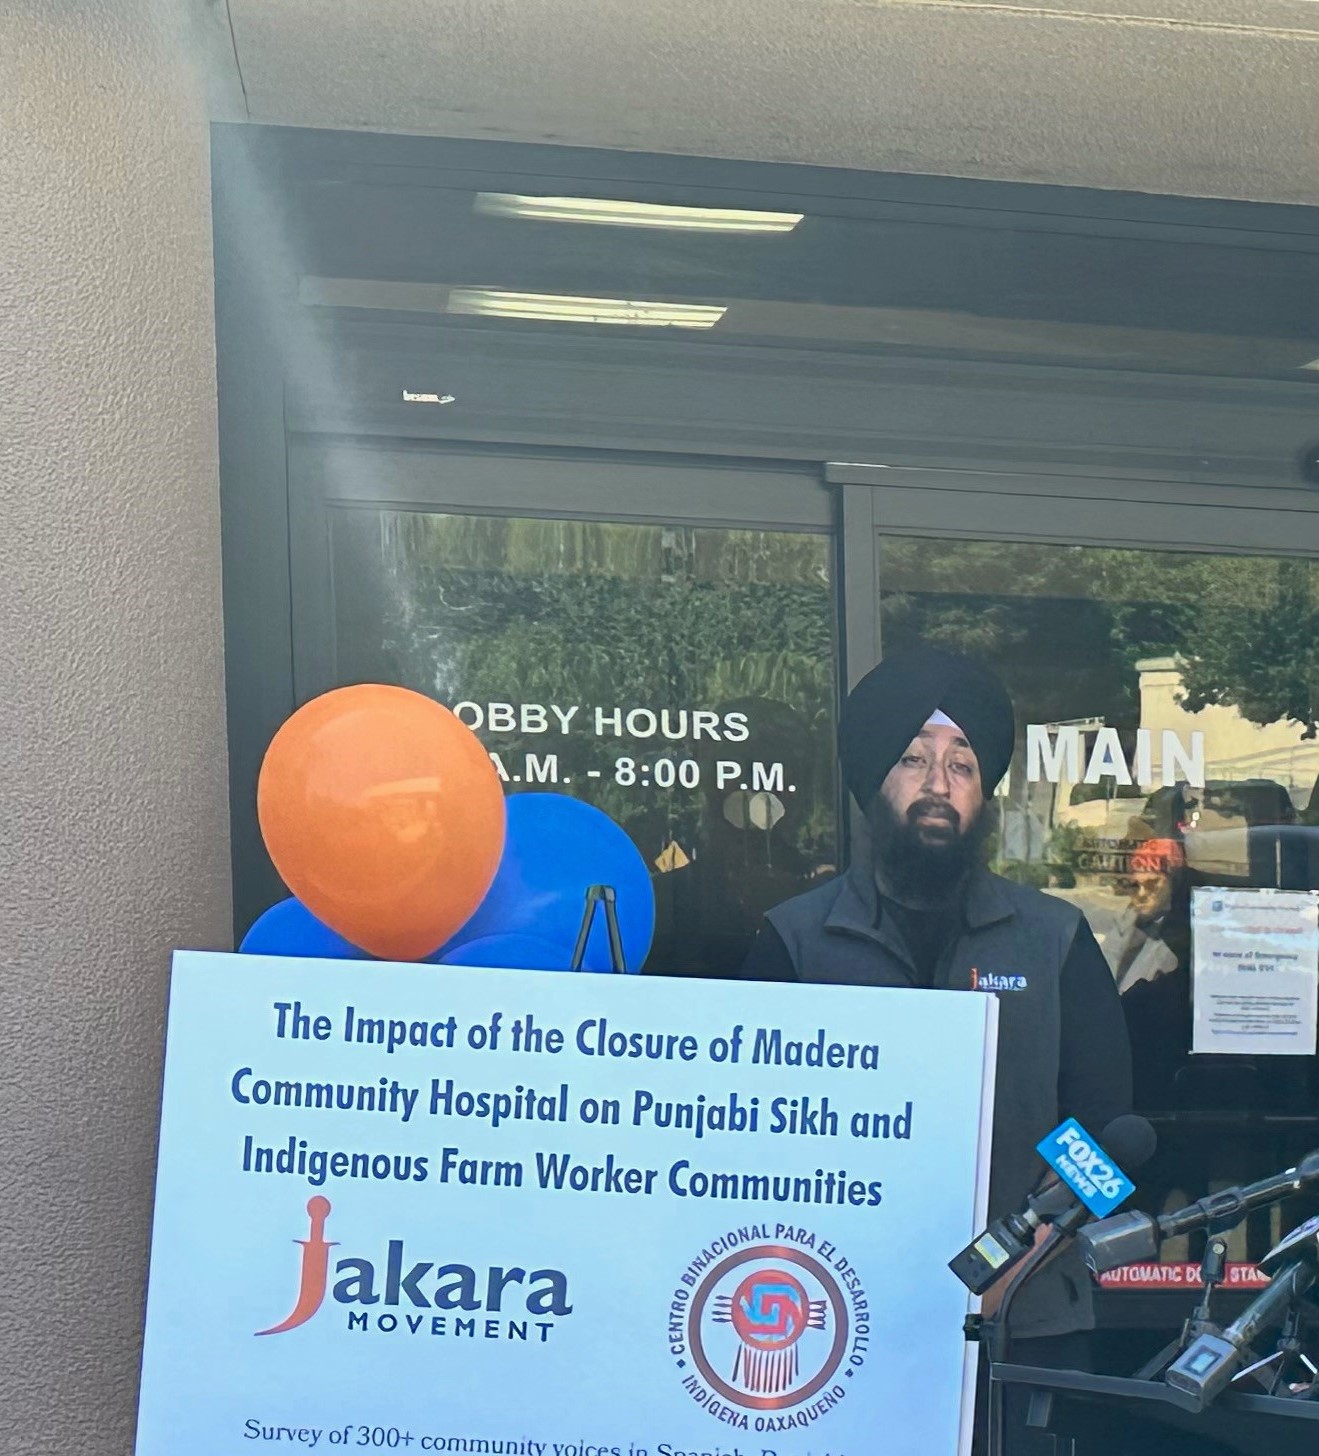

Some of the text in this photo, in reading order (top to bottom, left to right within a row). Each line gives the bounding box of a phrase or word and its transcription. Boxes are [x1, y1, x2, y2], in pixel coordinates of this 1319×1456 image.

[595, 707, 749, 742] HOURS
[1025, 724, 1206, 788] MAIN
[489, 752, 571, 784] A.M.
[614, 758, 700, 789] 8:00
[716, 761, 797, 792] P.M.
[273, 1003, 880, 1070] The Impact of the Closure of Madera
[231, 1069, 913, 1140] Community Hospital on Punjabi Sikh and
[242, 1137, 882, 1206] Indigenous Farm Worker Communities
[1056, 1126, 1124, 1201] FOX26
[254, 1195, 573, 1337] jakara
[668, 1223, 870, 1366] CENTRO BINACIONAL PARA EL DESARROLLO
[1100, 1266, 1181, 1282] AUTOMATIC
[347, 1312, 555, 1342] MOVEMENT
[244, 1419, 322, 1447] Survey
[329, 1425, 353, 1445] of
[356, 1426, 415, 1448] 300+
